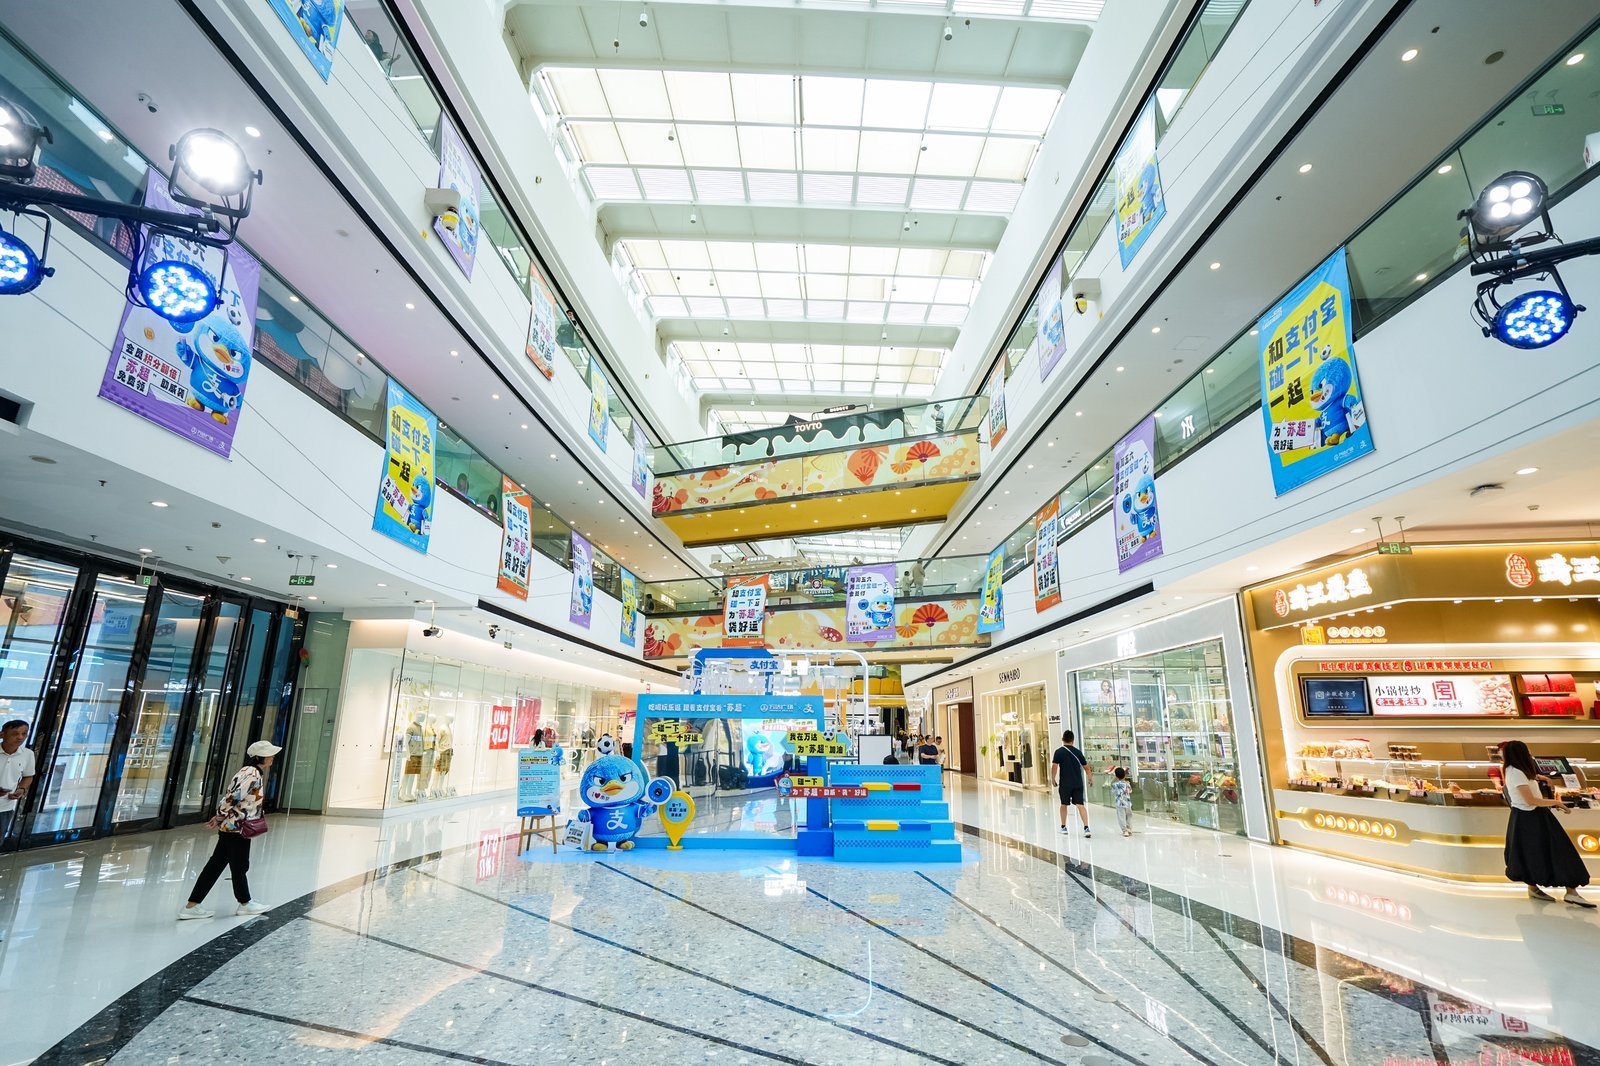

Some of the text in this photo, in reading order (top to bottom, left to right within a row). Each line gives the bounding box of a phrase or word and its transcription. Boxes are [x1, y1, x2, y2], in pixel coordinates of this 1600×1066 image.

[1268, 294, 1337, 366] 和支付宝
[126, 343, 178, 380] 会员积分翻倍
[1269, 336, 1319, 391] 碰一下
[116, 370, 146, 393] 免费领
[1270, 376, 1304, 408] 一起
[391, 410, 430, 453] 和支付宝
[795, 422, 822, 432] TOVTO
[1274, 421, 1311, 437] 为“苏超”
[391, 431, 421, 466] 碰一下
[1273, 439, 1294, 450] 袋好运
[390, 457, 410, 483] 一起
[507, 500, 528, 525] 和支付宝
[507, 517, 523, 537] 碰一下
[504, 552, 526, 579] 袋好运
[731, 588, 762, 598] 和支付宝
[730, 599, 754, 608] 碰一下
[728, 621, 758, 633] 袋好运
[750, 660, 779, 670] 支付宝
[494, 710, 509, 725] UNI
[492, 728, 508, 746] QLO
[658, 724, 680, 733] 碰一下
[789, 732, 818, 741] 我在万达
